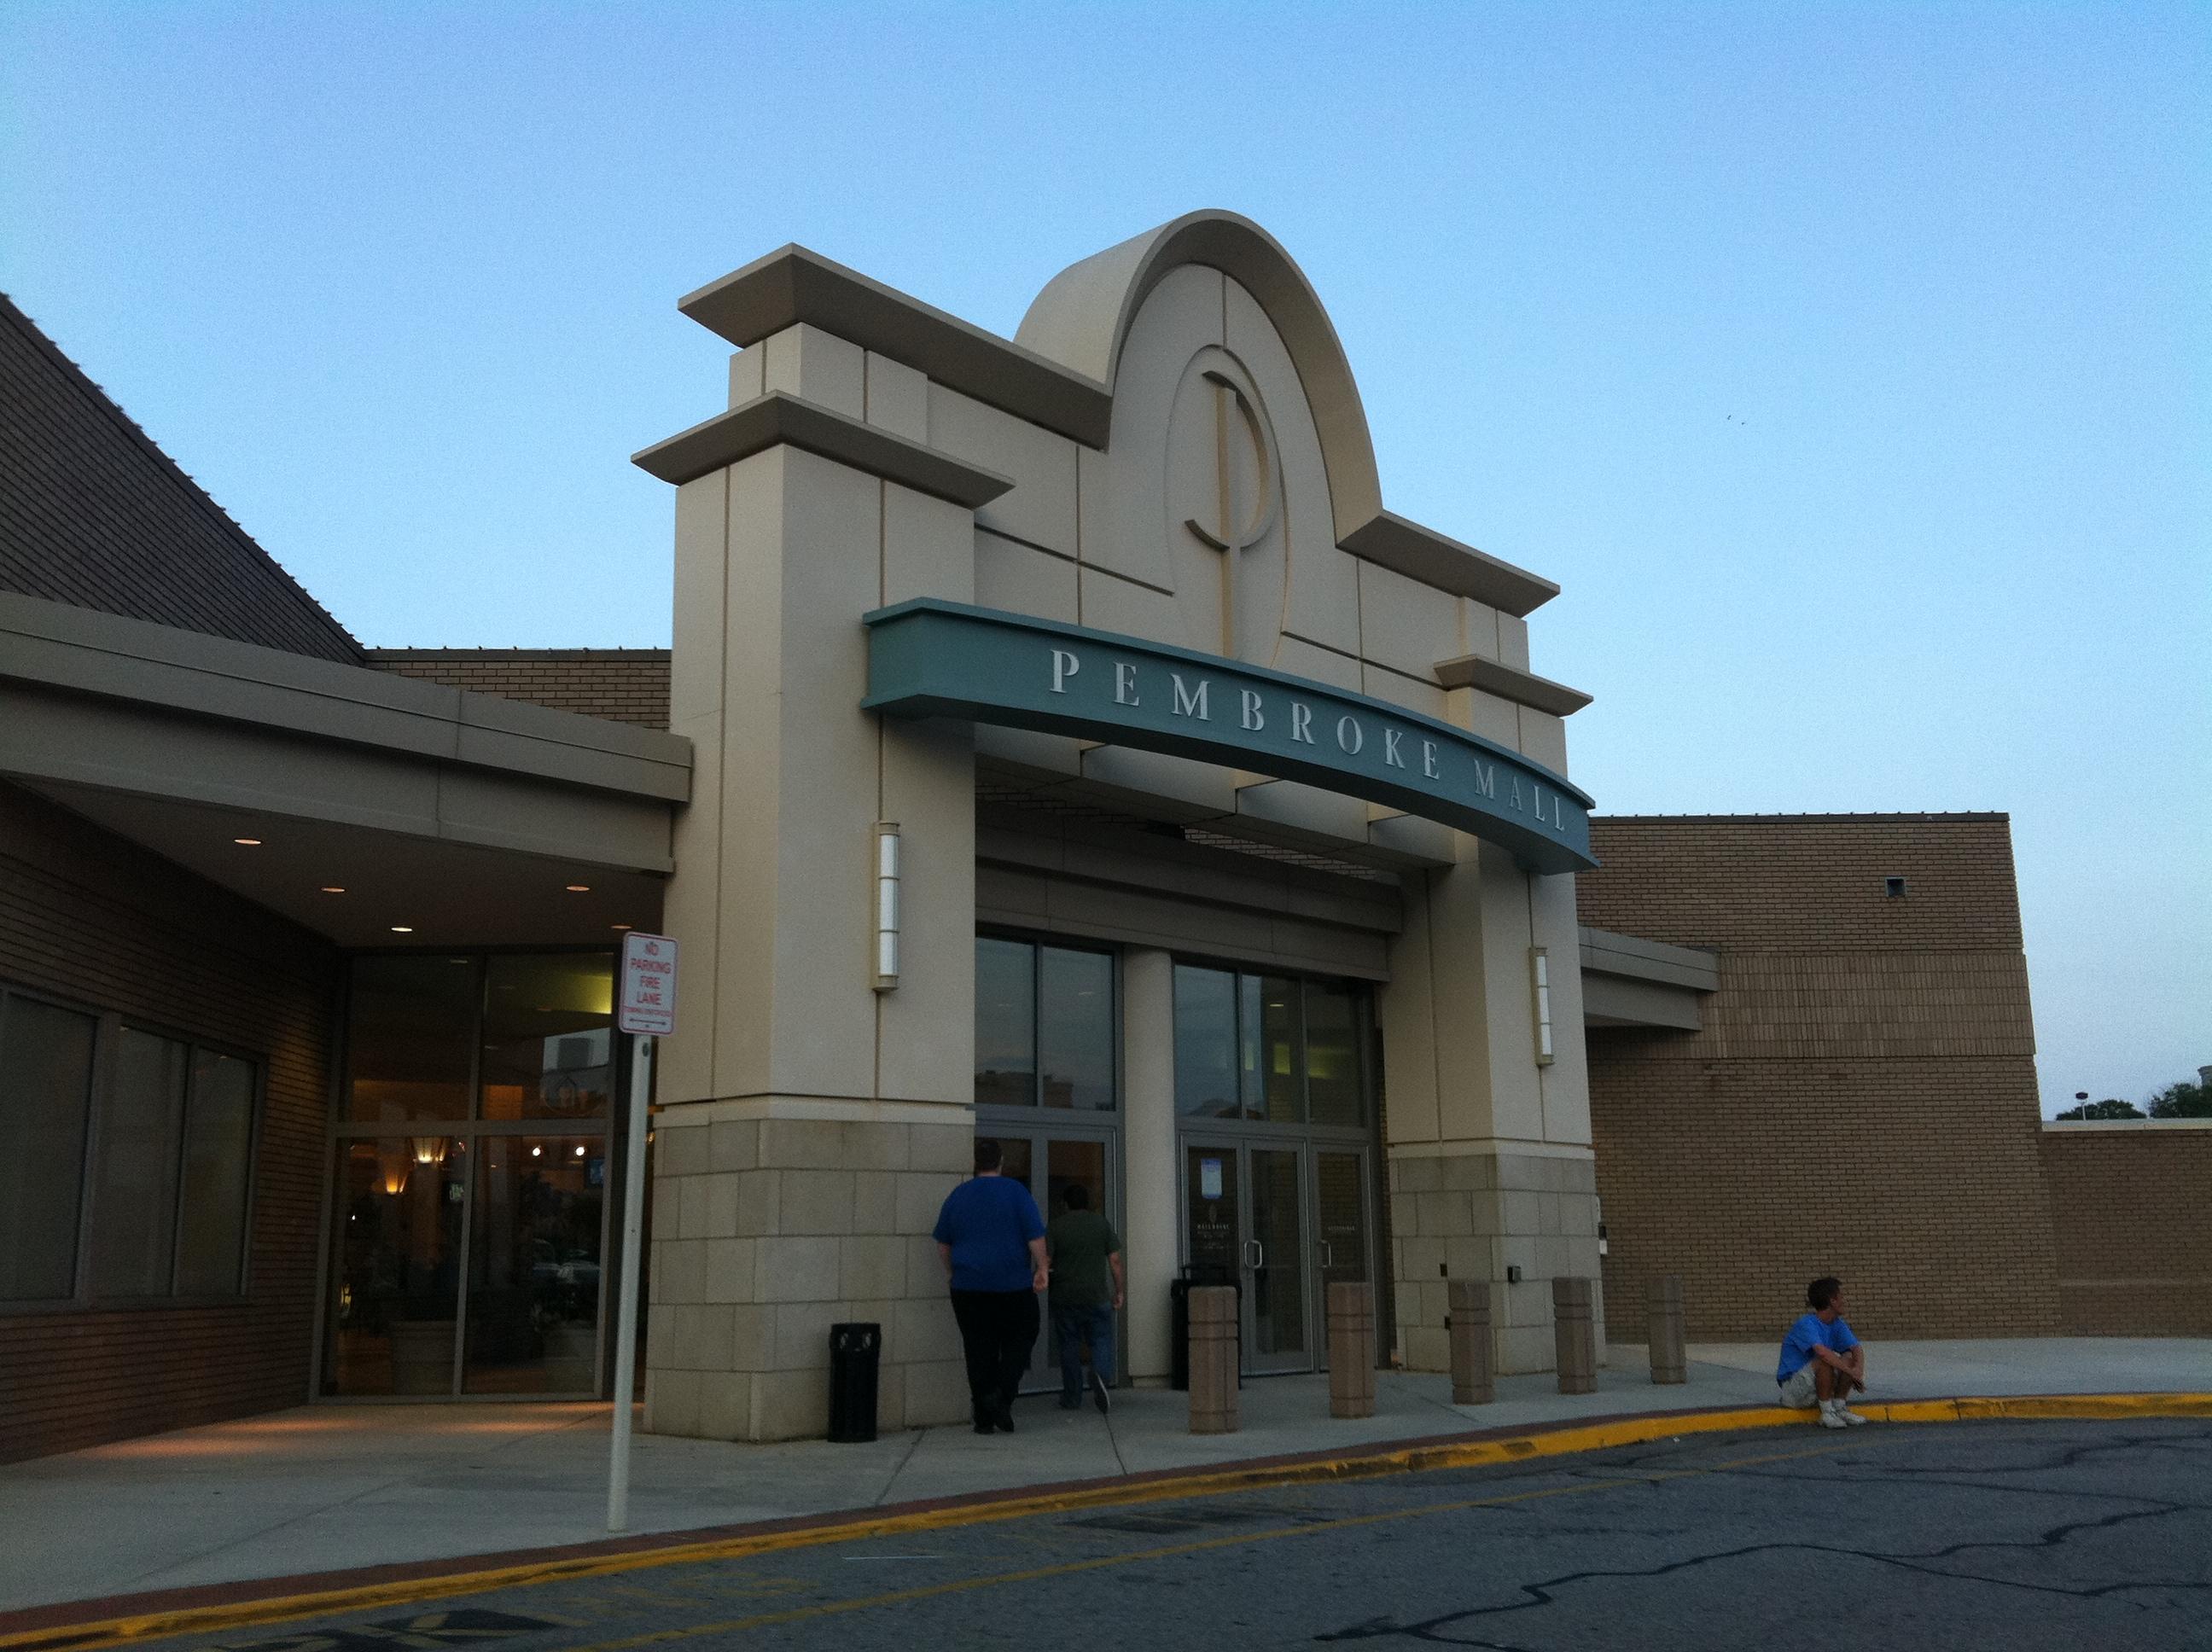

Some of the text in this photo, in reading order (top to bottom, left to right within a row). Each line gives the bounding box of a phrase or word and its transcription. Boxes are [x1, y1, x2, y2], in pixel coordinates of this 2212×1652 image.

[1049, 649, 1565, 832] PEMBROKE MALL
[631, 957, 672, 974] PARKING
[641, 975, 661, 989] FIRE
[637, 991, 661, 1005] LANE
